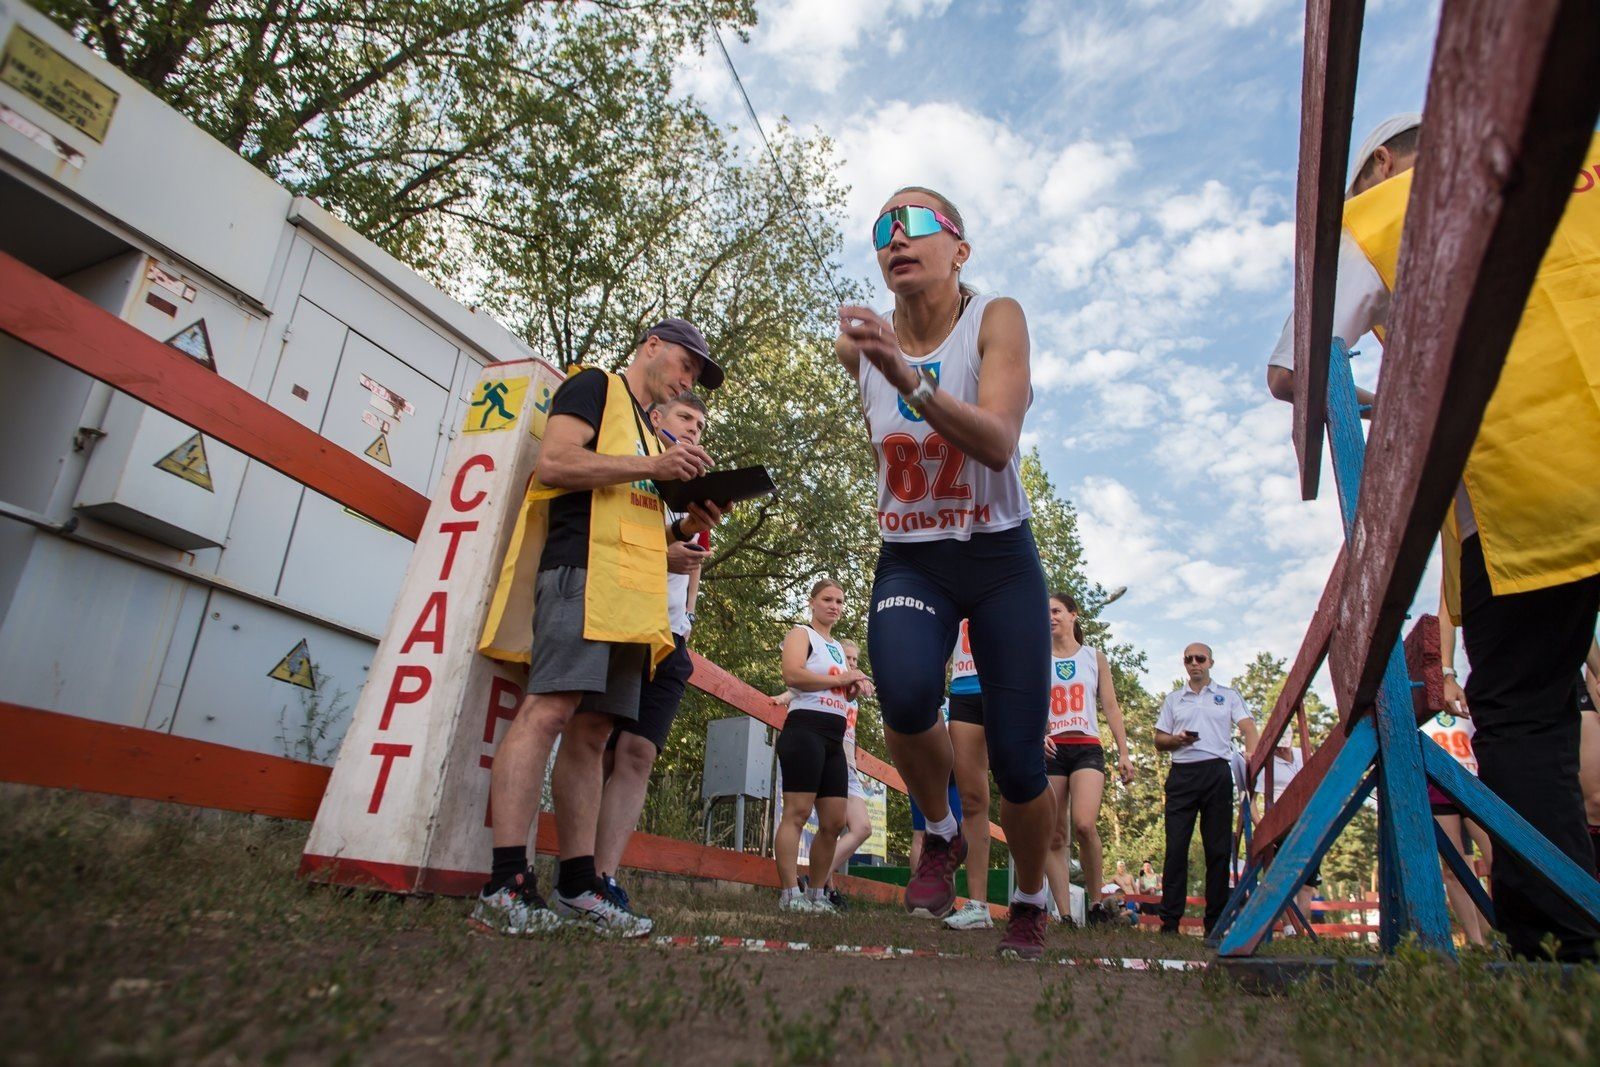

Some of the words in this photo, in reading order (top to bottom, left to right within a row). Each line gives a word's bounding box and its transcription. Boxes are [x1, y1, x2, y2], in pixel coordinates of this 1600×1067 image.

[881, 432, 972, 504] 82
[876, 595, 925, 613] BOSCO
[367, 454, 494, 815] СТАРТ
[1049, 683, 1086, 716] 88
